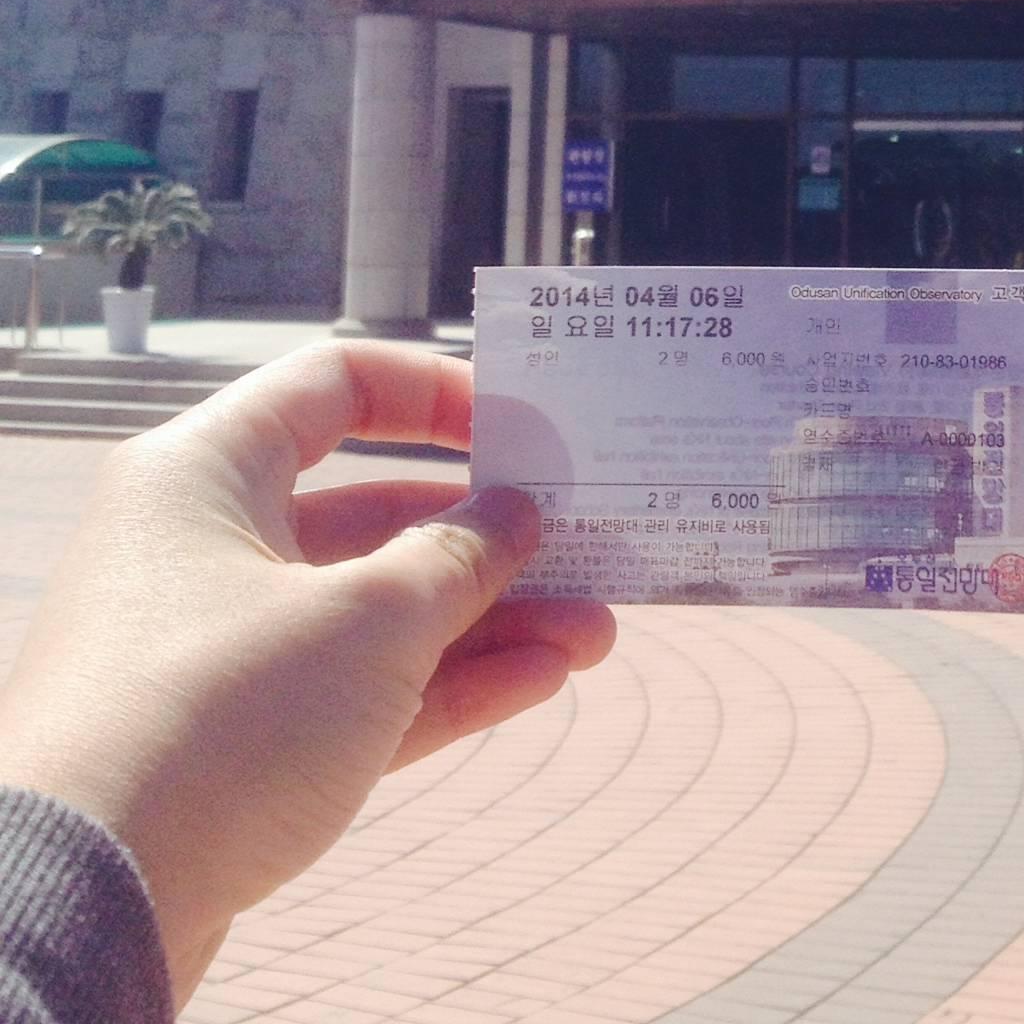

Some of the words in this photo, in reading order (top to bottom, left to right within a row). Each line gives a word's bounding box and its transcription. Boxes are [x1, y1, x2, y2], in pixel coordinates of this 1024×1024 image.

[529, 284, 614, 308] 2014년
[625, 284, 678, 308] 04월
[689, 284, 744, 309] 06일
[791, 286, 838, 299] Odusan
[843, 286, 905, 300] Unification
[910, 287, 983, 303] Observatory
[626, 316, 733, 338] 11:17:28
[526, 350, 560, 367] 성인
[721, 351, 766, 367] 6,000
[901, 353, 1007, 370] 210-83-01986
[804, 377, 871, 393] 승인번호
[921, 432, 1005, 448] A-0000103
[711, 493, 760, 510] 6,000
[542, 518, 569, 535] 금은
[574, 517, 638, 535] 통일전망대
[643, 518, 670, 535] 관리
[675, 518, 727, 535] 유지비로
[732, 519, 771, 536] 사용됨
